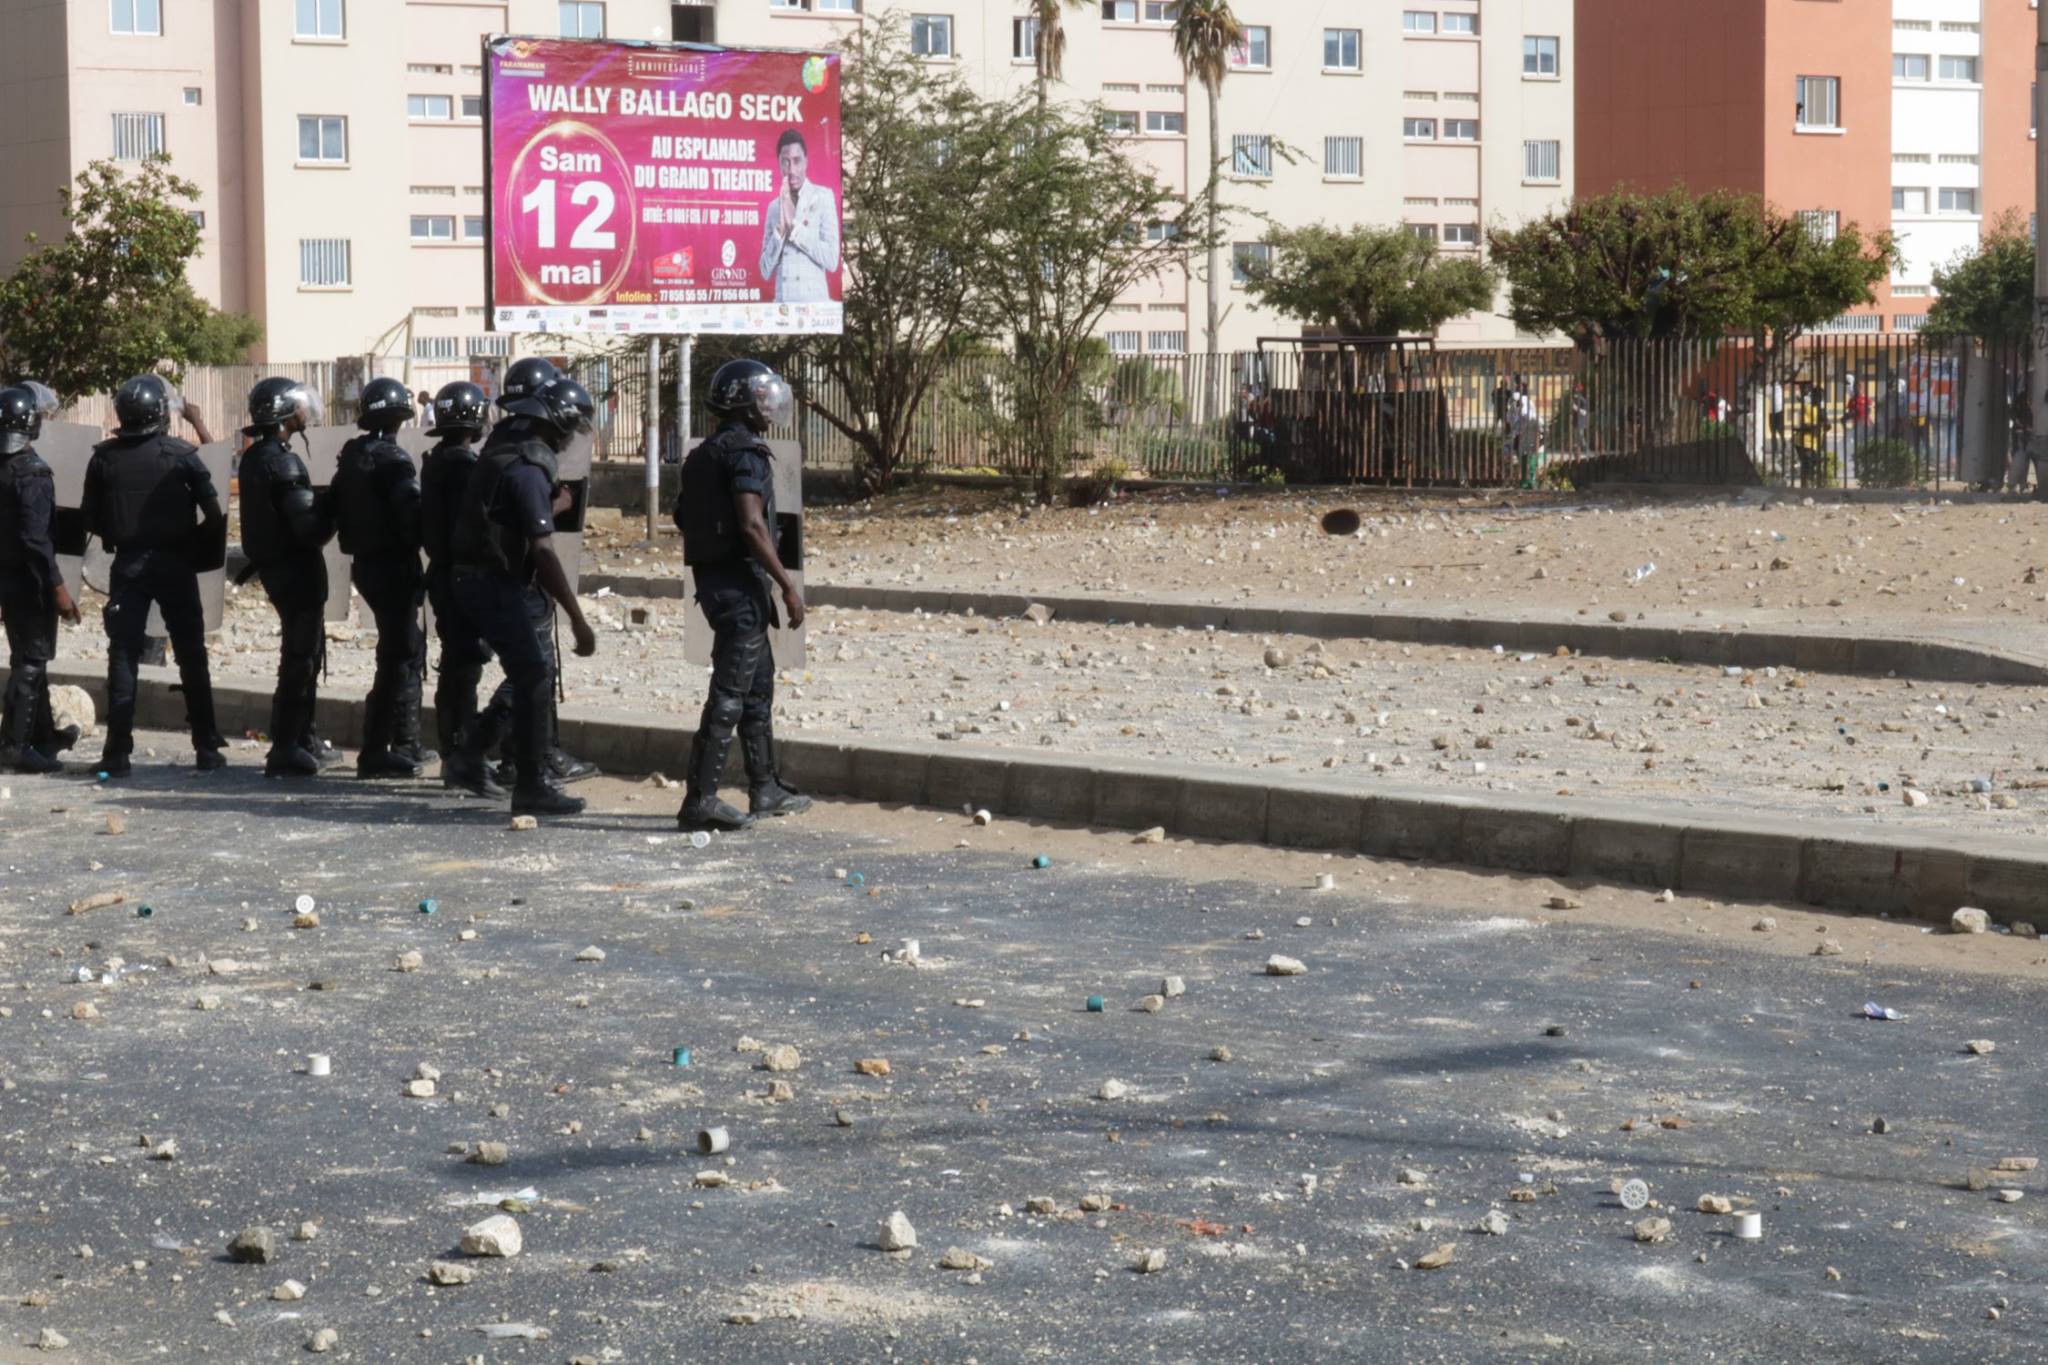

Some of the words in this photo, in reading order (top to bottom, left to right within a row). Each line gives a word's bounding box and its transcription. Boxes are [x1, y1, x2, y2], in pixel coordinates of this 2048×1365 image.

[528, 84, 611, 114] WALLY
[620, 88, 732, 120] BALLAGO
[740, 93, 803, 122] SECK
[540, 146, 602, 172] Sam
[651, 136, 672, 159] AU
[675, 137, 756, 162] ESPLANADE
[634, 165, 656, 188] DU
[658, 166, 709, 190] GRAND
[712, 168, 772, 192] THEATRE
[522, 179, 615, 249] 12
[540, 260, 602, 285] mai
[616, 291, 653, 303] Infoline
